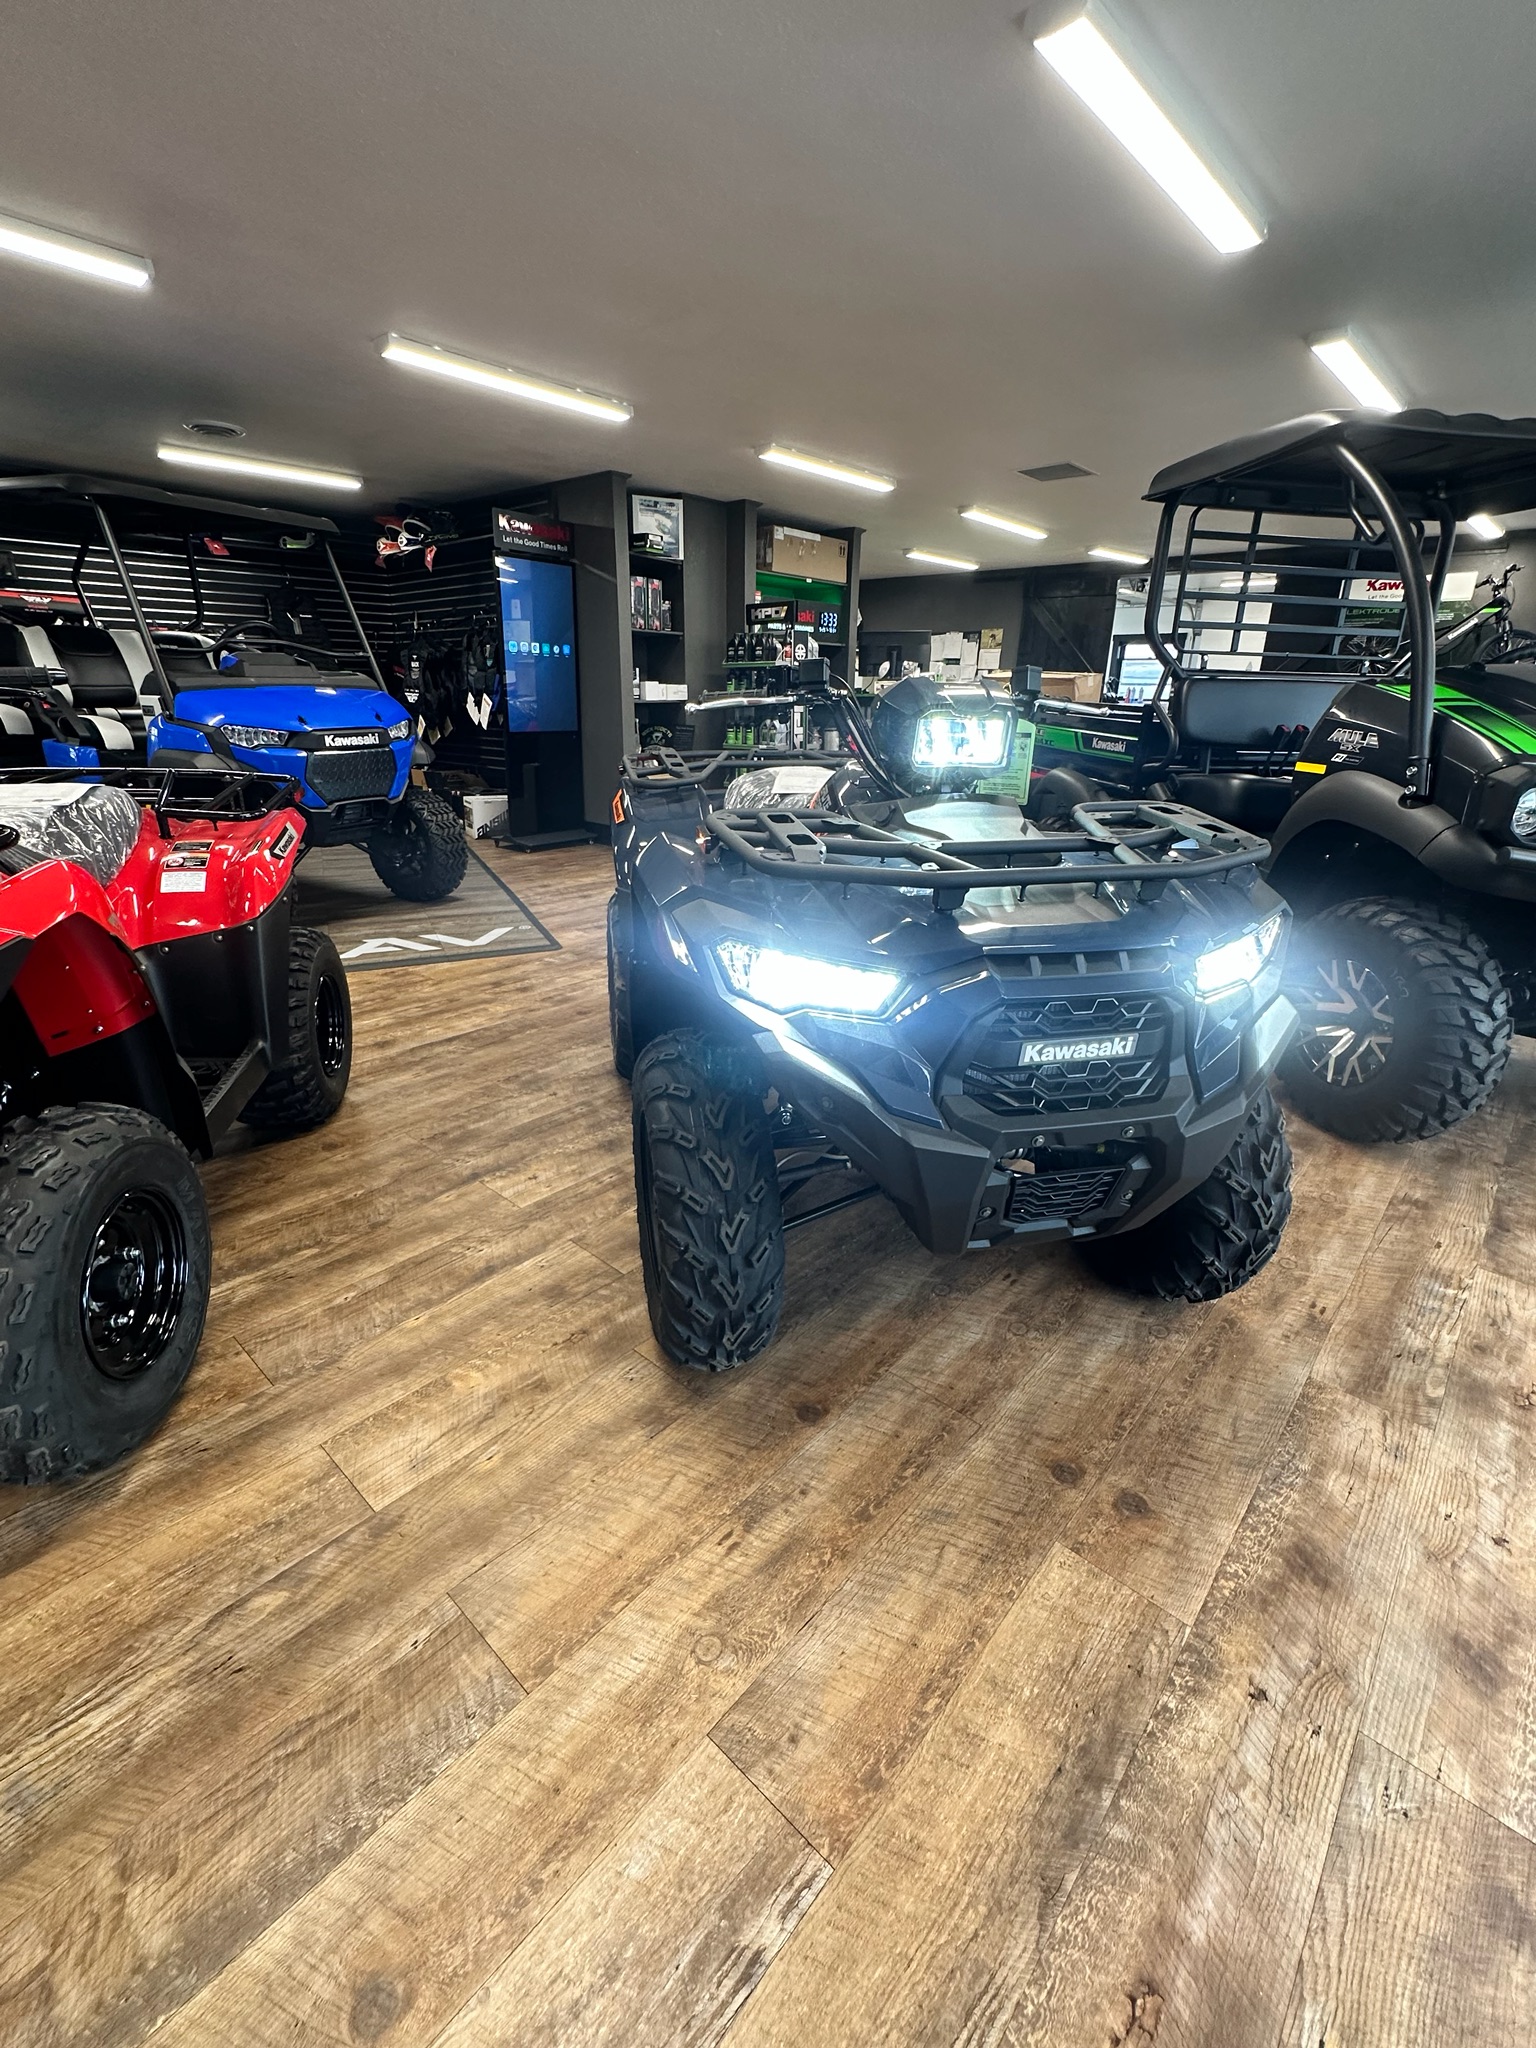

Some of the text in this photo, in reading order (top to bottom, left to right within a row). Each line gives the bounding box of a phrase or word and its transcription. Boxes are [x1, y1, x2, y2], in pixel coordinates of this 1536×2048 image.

[503, 534, 512, 543] Let
[513, 537, 523, 545] the
[524, 538, 539, 548] Good
[540, 541, 556, 551] Times
[324, 733, 380, 747] Kawasaki
[1091, 737, 1126, 753] Kawasaki
[1327, 728, 1379, 749] MULE
[1023, 1037, 1134, 1063] Kawasaki
